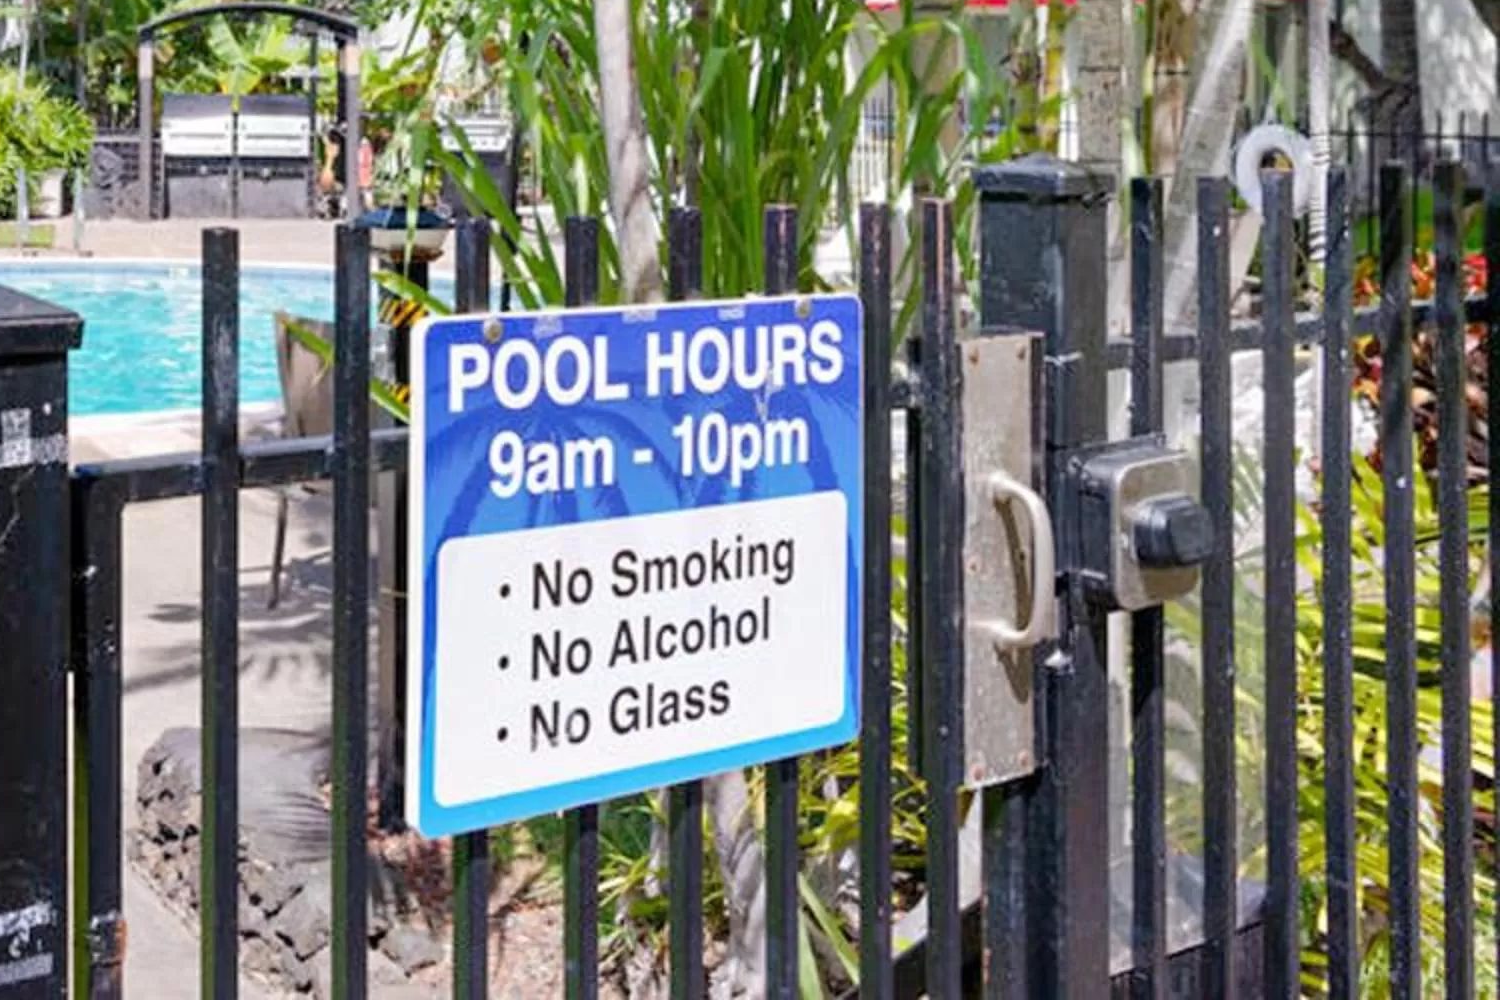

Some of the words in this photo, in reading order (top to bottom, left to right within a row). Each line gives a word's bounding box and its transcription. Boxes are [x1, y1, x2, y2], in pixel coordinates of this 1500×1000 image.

[448, 335, 629, 413] POOL
[646, 320, 843, 397] HOURS
[489, 431, 614, 498] 9am
[633, 449, 653, 464] -
[673, 412, 809, 488] 10pm
[532, 560, 593, 610] No
[611, 536, 795, 597] Smoking
[531, 630, 592, 681] No
[608, 596, 770, 667] Alcohol
[530, 700, 591, 751] No
[609, 679, 731, 736] Glass
